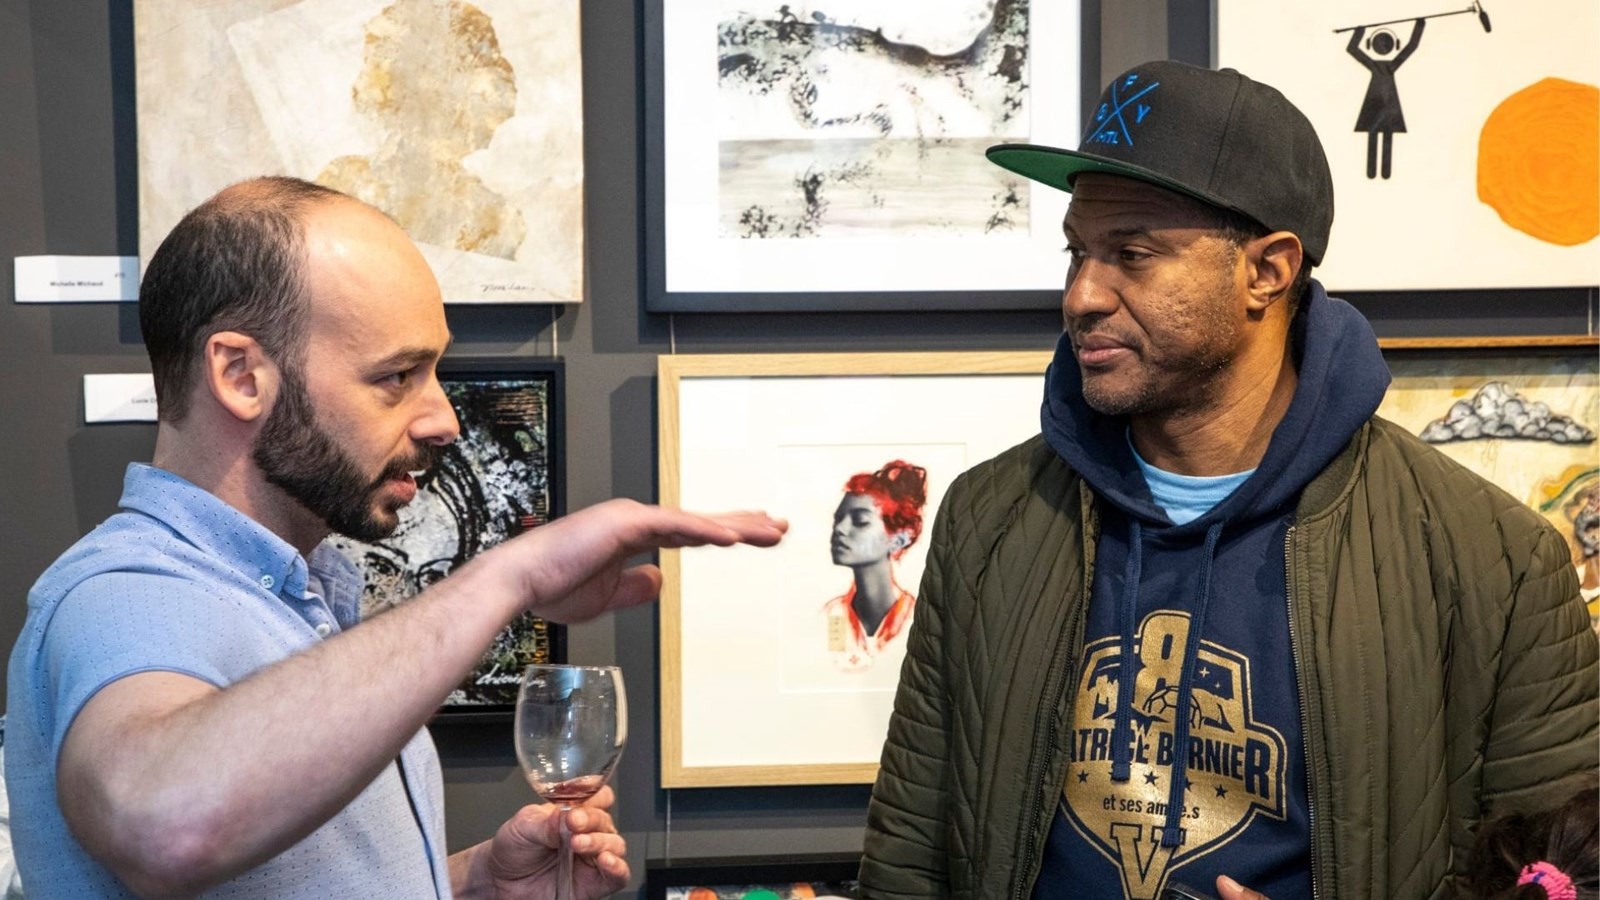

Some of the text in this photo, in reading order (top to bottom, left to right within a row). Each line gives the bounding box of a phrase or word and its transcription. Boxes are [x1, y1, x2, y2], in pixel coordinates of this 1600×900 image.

[1135, 103, 1152, 124] Y
[1156, 731, 1271, 800] BRNIER
[1103, 794, 1200, 819] et ses ame.s
